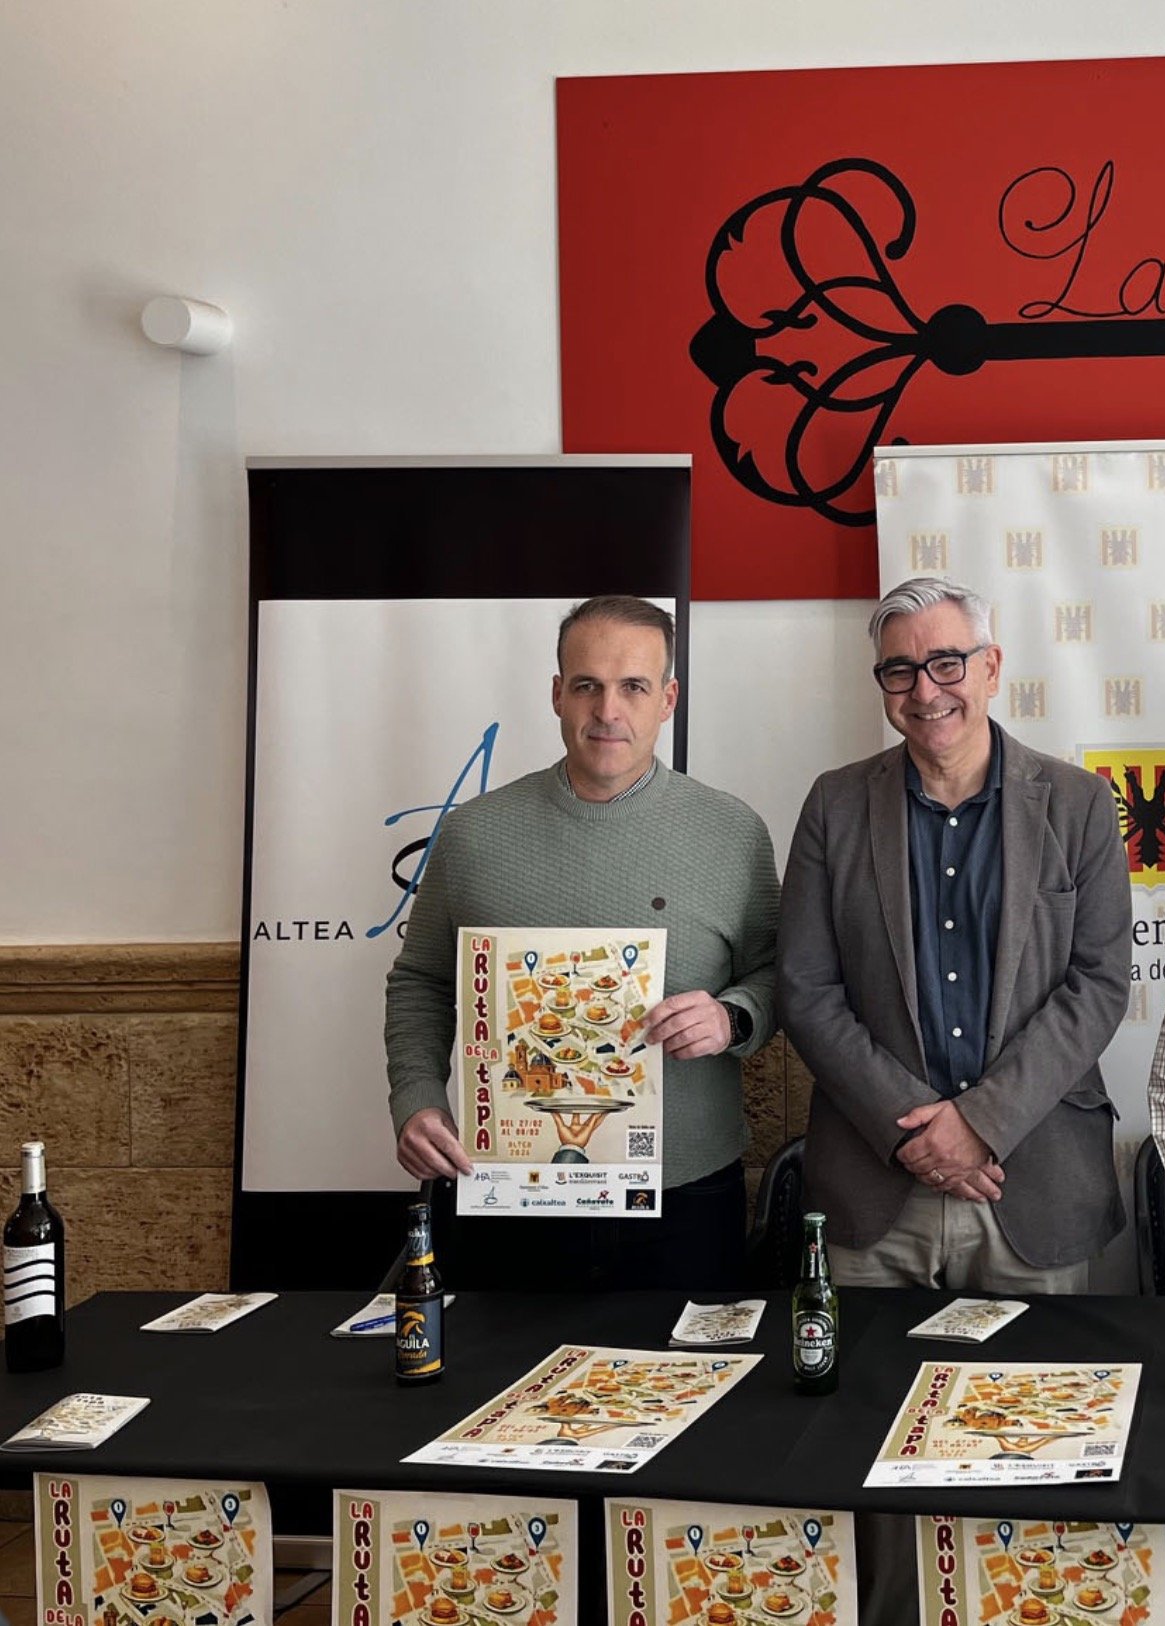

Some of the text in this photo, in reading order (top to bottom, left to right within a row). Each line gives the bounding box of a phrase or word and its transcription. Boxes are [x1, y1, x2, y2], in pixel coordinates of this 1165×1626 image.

[253, 921, 354, 940] ALTEA
[472, 938, 490, 951] LA
[50, 1482, 71, 1498] LA
[351, 1503, 373, 1519] LA
[622, 1510, 645, 1526] LA
